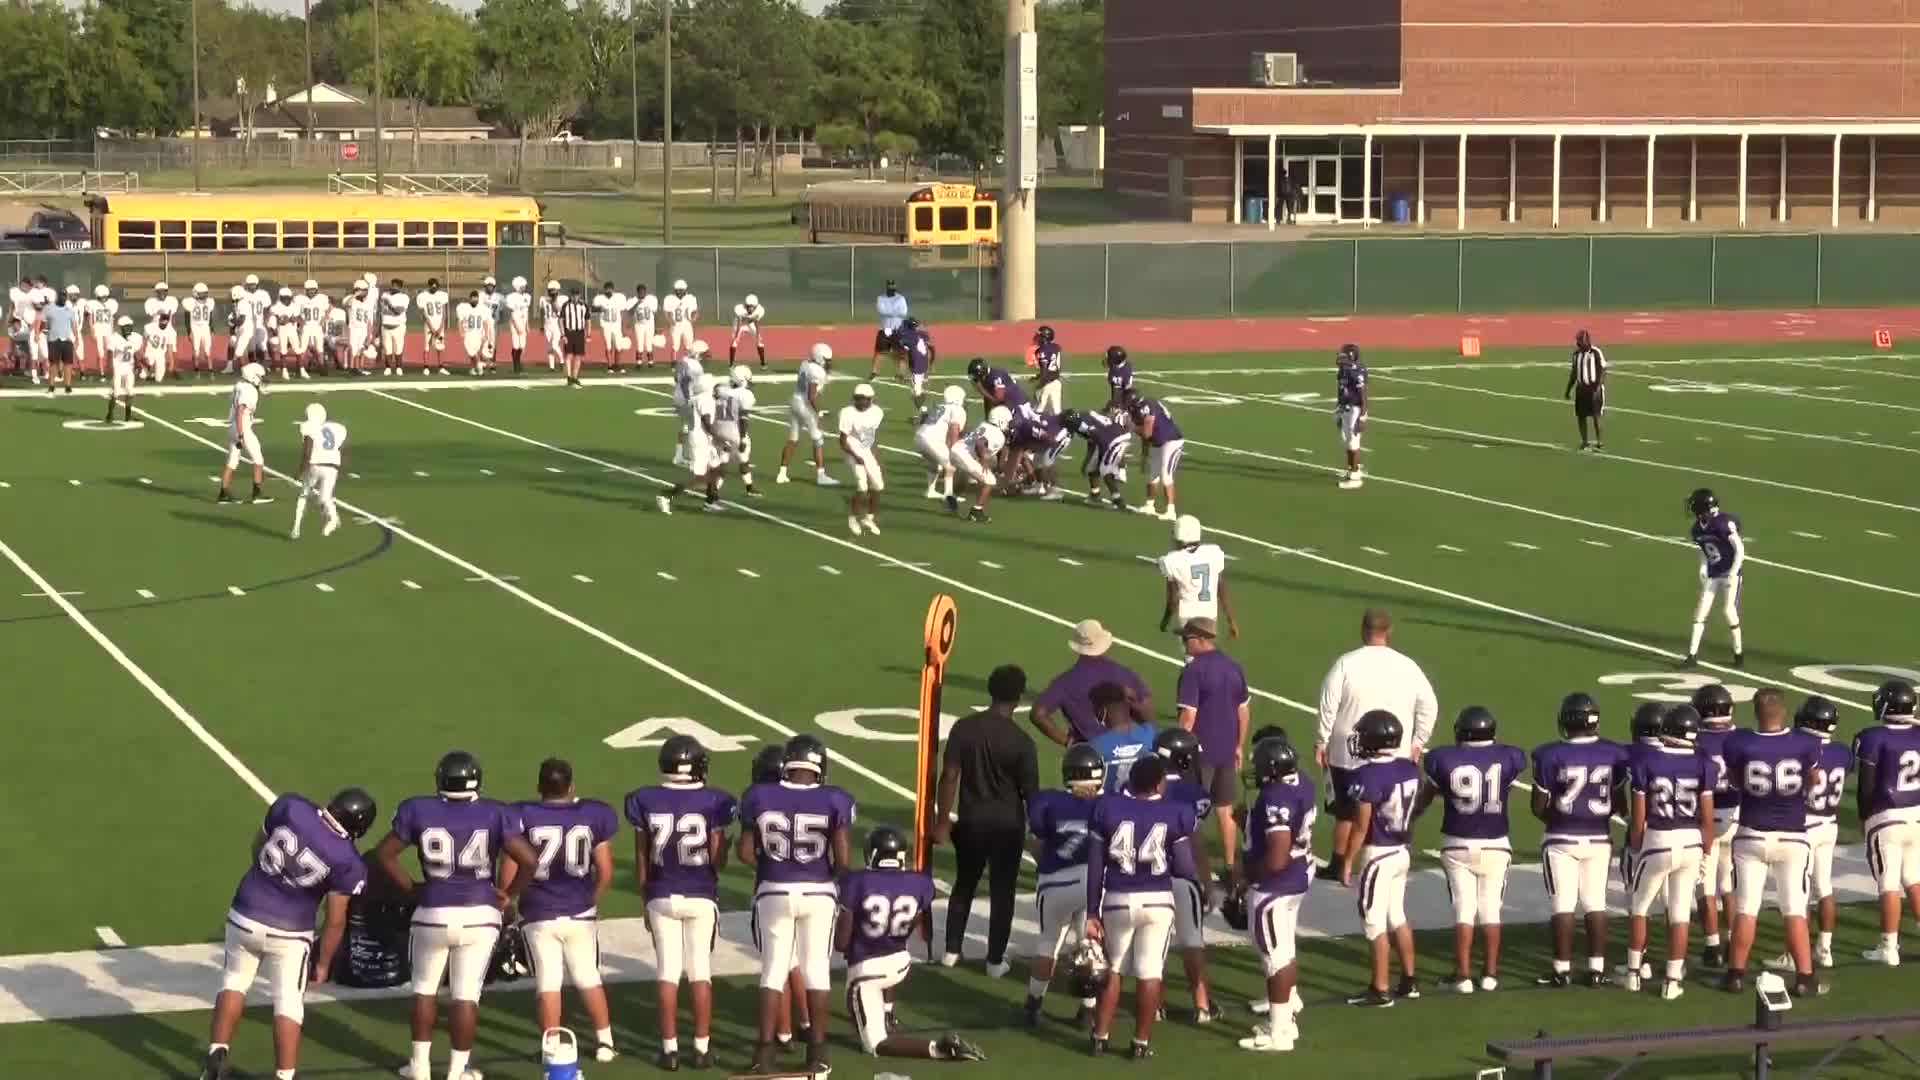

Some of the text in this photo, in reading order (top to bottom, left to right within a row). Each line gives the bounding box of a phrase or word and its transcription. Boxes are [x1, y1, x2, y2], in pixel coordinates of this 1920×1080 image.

[1190, 563, 1211, 602] 7
[1450, 763, 1503, 815] 91
[1557, 765, 1613, 815] 73
[1744, 758, 1803, 798] 66
[258, 824, 331, 888] 67
[420, 826, 493, 880] 94
[528, 824, 594, 880] 70
[649, 813, 709, 866] 72
[757, 810, 830, 864] 65
[1109, 820, 1169, 877] 44
[861, 894, 920, 938] 32
